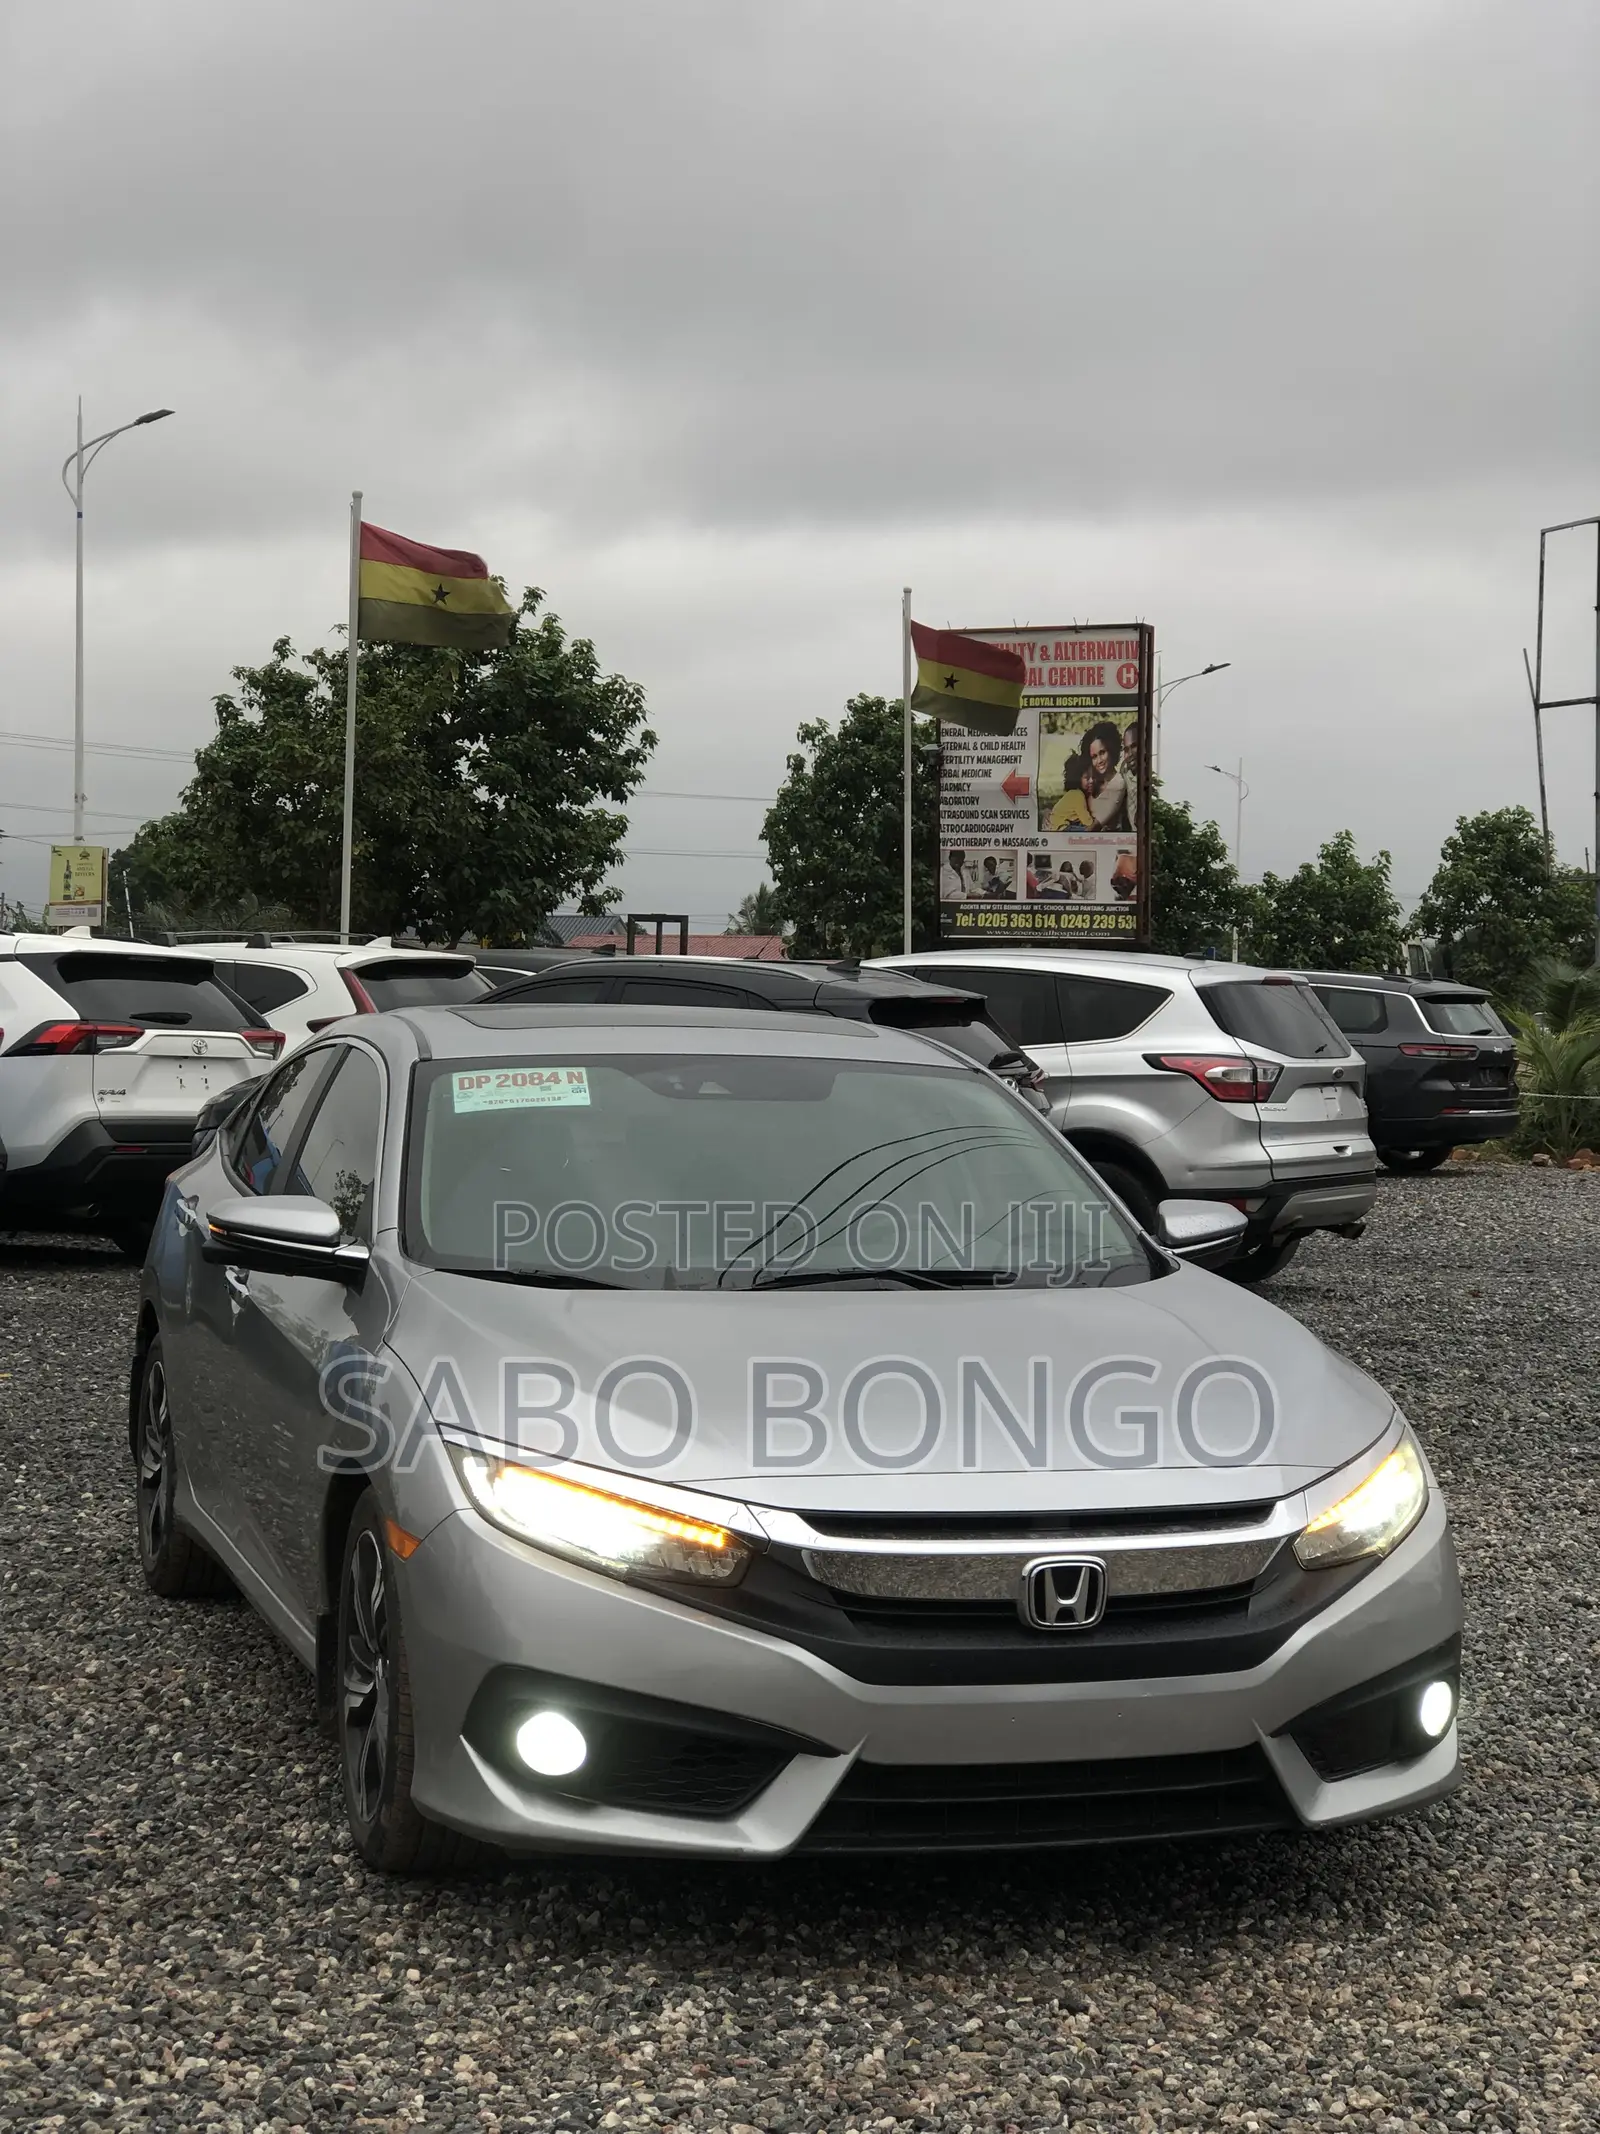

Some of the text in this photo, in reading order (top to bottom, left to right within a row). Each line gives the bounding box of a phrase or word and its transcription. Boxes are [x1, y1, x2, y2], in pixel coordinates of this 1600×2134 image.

[1040, 644, 1050, 660] &
[1048, 666, 1104, 686] CENTRE
[1029, 697, 1054, 706] ROYAL
[1056, 696, 1095, 706] HOSPITAL
[972, 741, 979, 751] &
[980, 741, 999, 751] CHILD
[1001, 740, 1026, 751] HEALTH
[976, 754, 1022, 765] MANAGEMENT
[961, 768, 993, 778] MEDICINE
[980, 809, 999, 819] SCAN
[1000, 809, 1030, 819] SERVICES
[1002, 837, 1040, 847] MASSAGING
[955, 913, 976, 927] Tel:
[977, 913, 1008, 928] 0205
[1010, 913, 1033, 928] 363
[1035, 913, 1058, 929] 614,
[1060, 914, 1091, 929] 0243
[1092, 914, 1116, 929] 239
[458, 1071, 585, 1091] DP 2084 N
